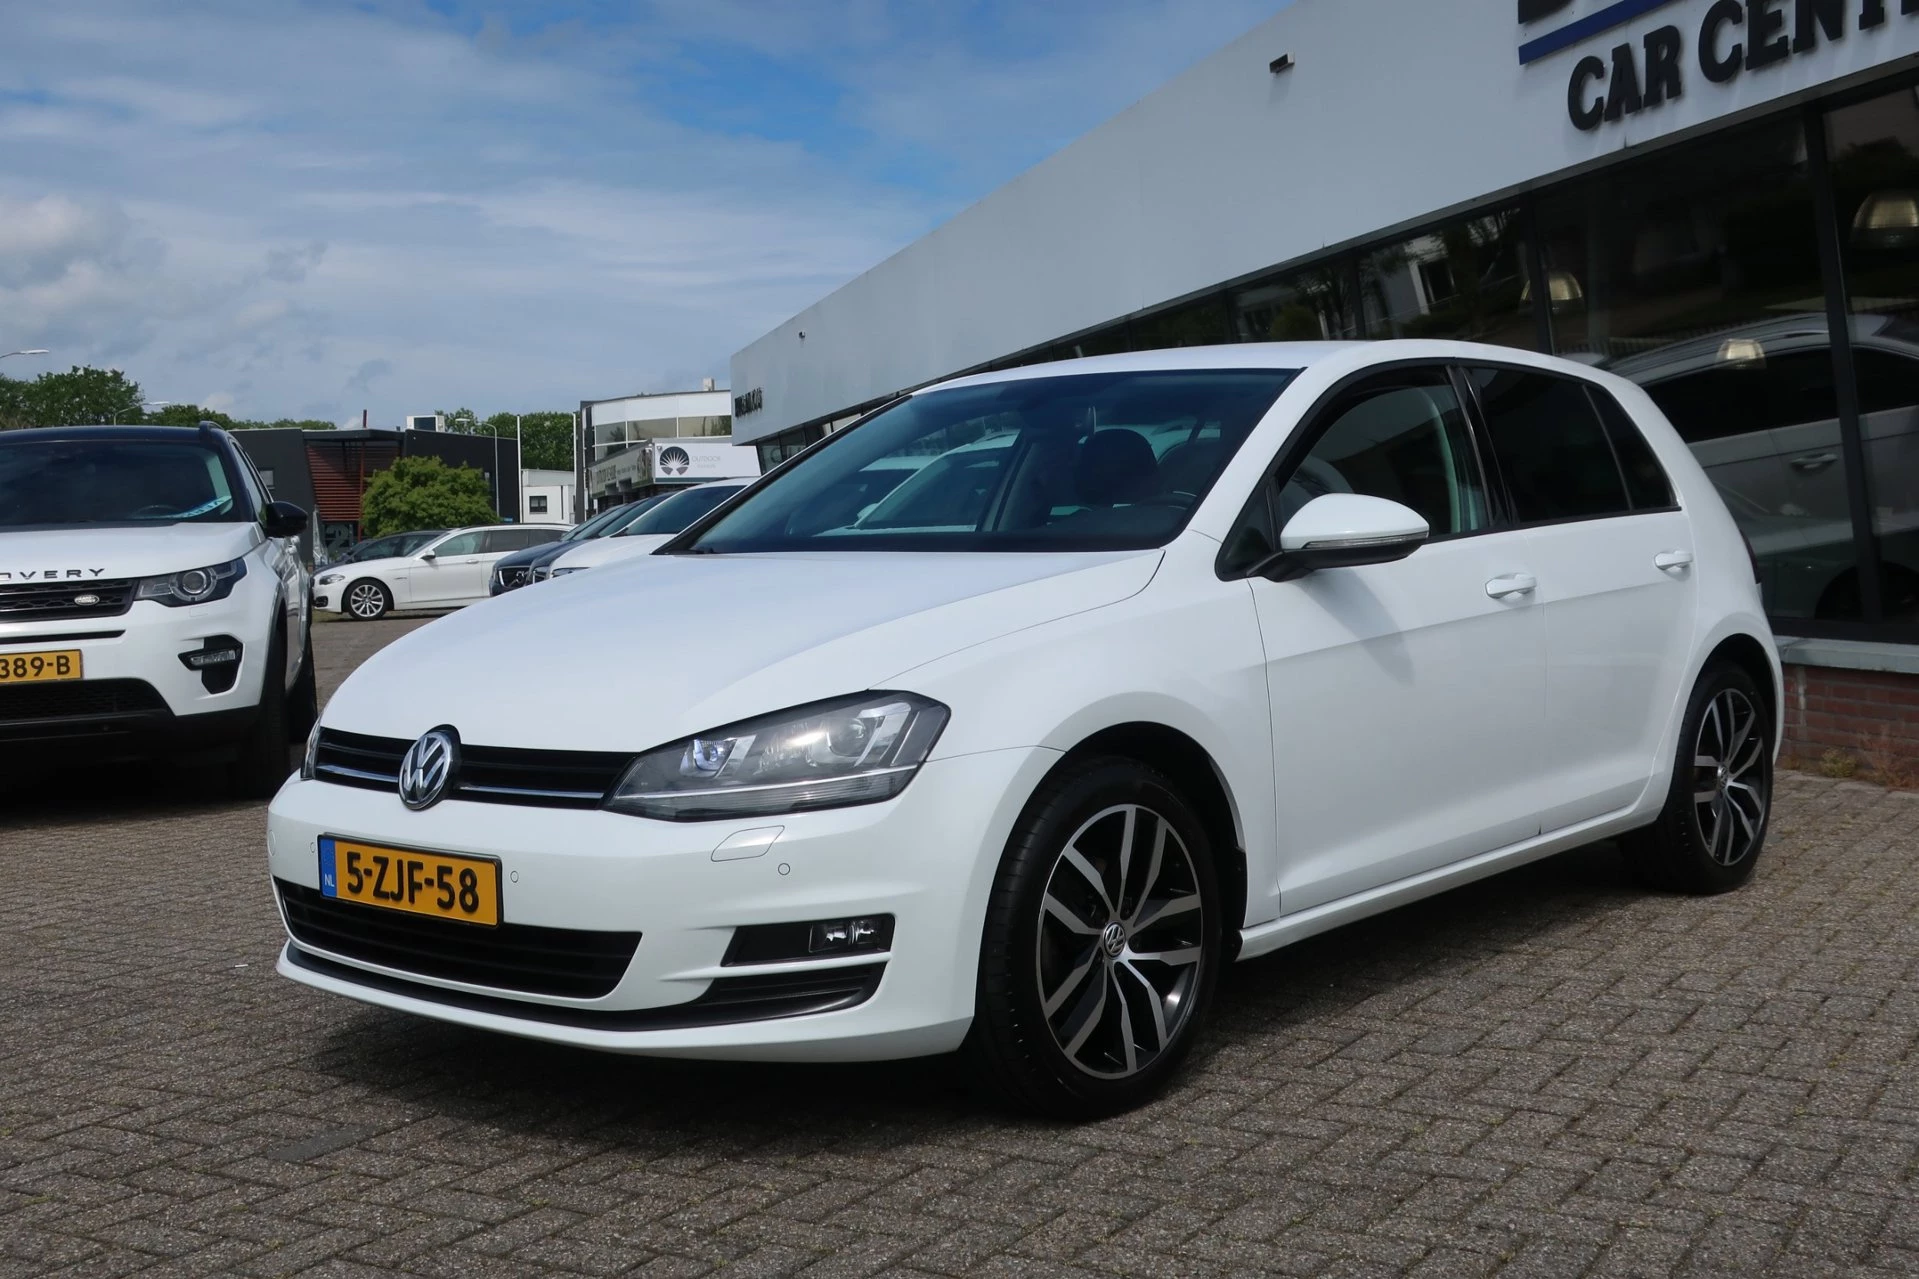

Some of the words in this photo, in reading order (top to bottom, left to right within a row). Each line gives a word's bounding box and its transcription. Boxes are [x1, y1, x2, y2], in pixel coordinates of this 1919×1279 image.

[1567, 24, 1682, 131] CAR
[1698, 0, 1919, 83] CEN
[324, 873, 335, 888] NL
[346, 850, 480, 914] 5-ZJF-58
